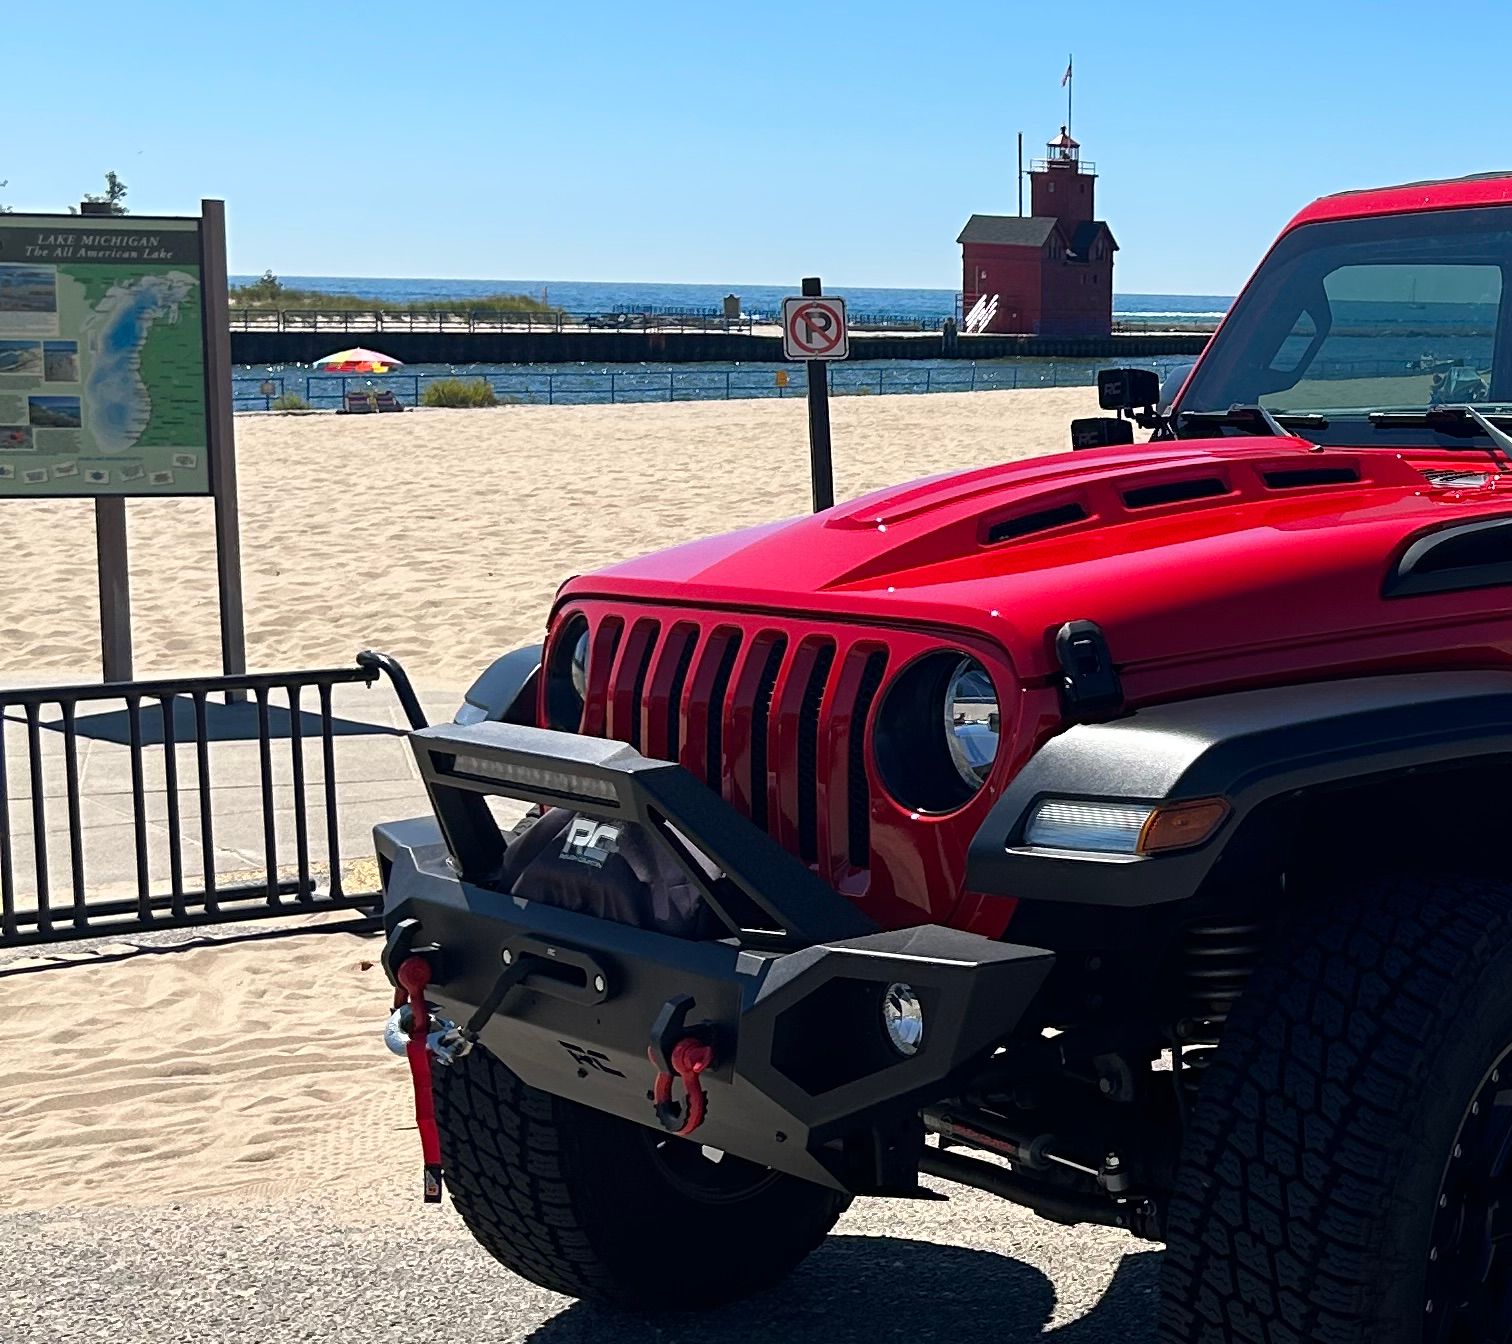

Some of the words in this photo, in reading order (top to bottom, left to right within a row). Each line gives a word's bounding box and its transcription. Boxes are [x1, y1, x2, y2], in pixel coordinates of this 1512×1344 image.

[38, 234, 76, 246] LAKE
[81, 235, 160, 247] MICHIGAN
[25, 246, 49, 257] The
[53, 247, 72, 257] All
[78, 248, 138, 259] American
[143, 248, 173, 260] Lake
[805, 312, 832, 344] P
[1104, 381, 1121, 396] RC
[562, 818, 620, 862] RC
